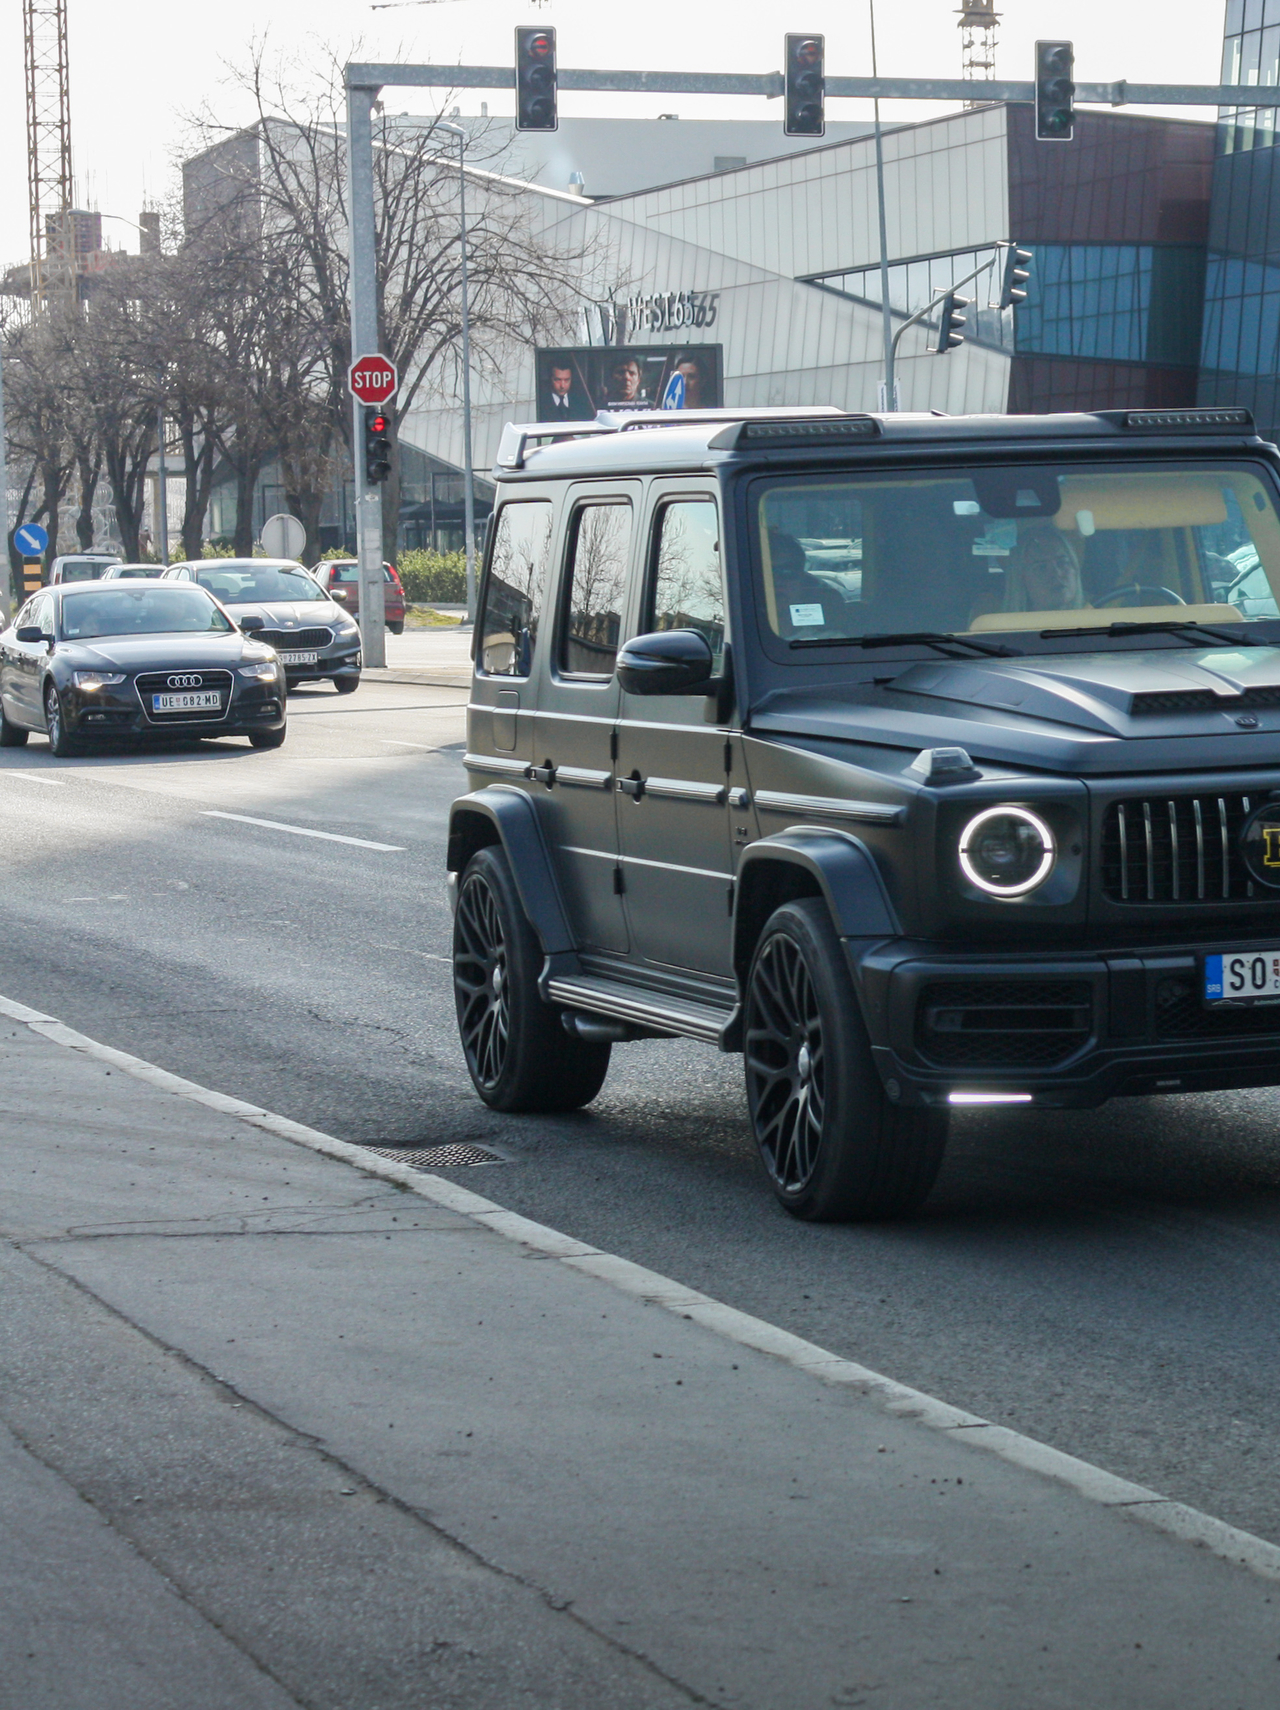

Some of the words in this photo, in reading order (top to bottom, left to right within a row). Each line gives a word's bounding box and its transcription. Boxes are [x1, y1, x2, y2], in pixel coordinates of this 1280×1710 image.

[354, 371, 392, 388] STOP
[1230, 957, 1266, 991] SO
[1207, 984, 1221, 993] SRB
